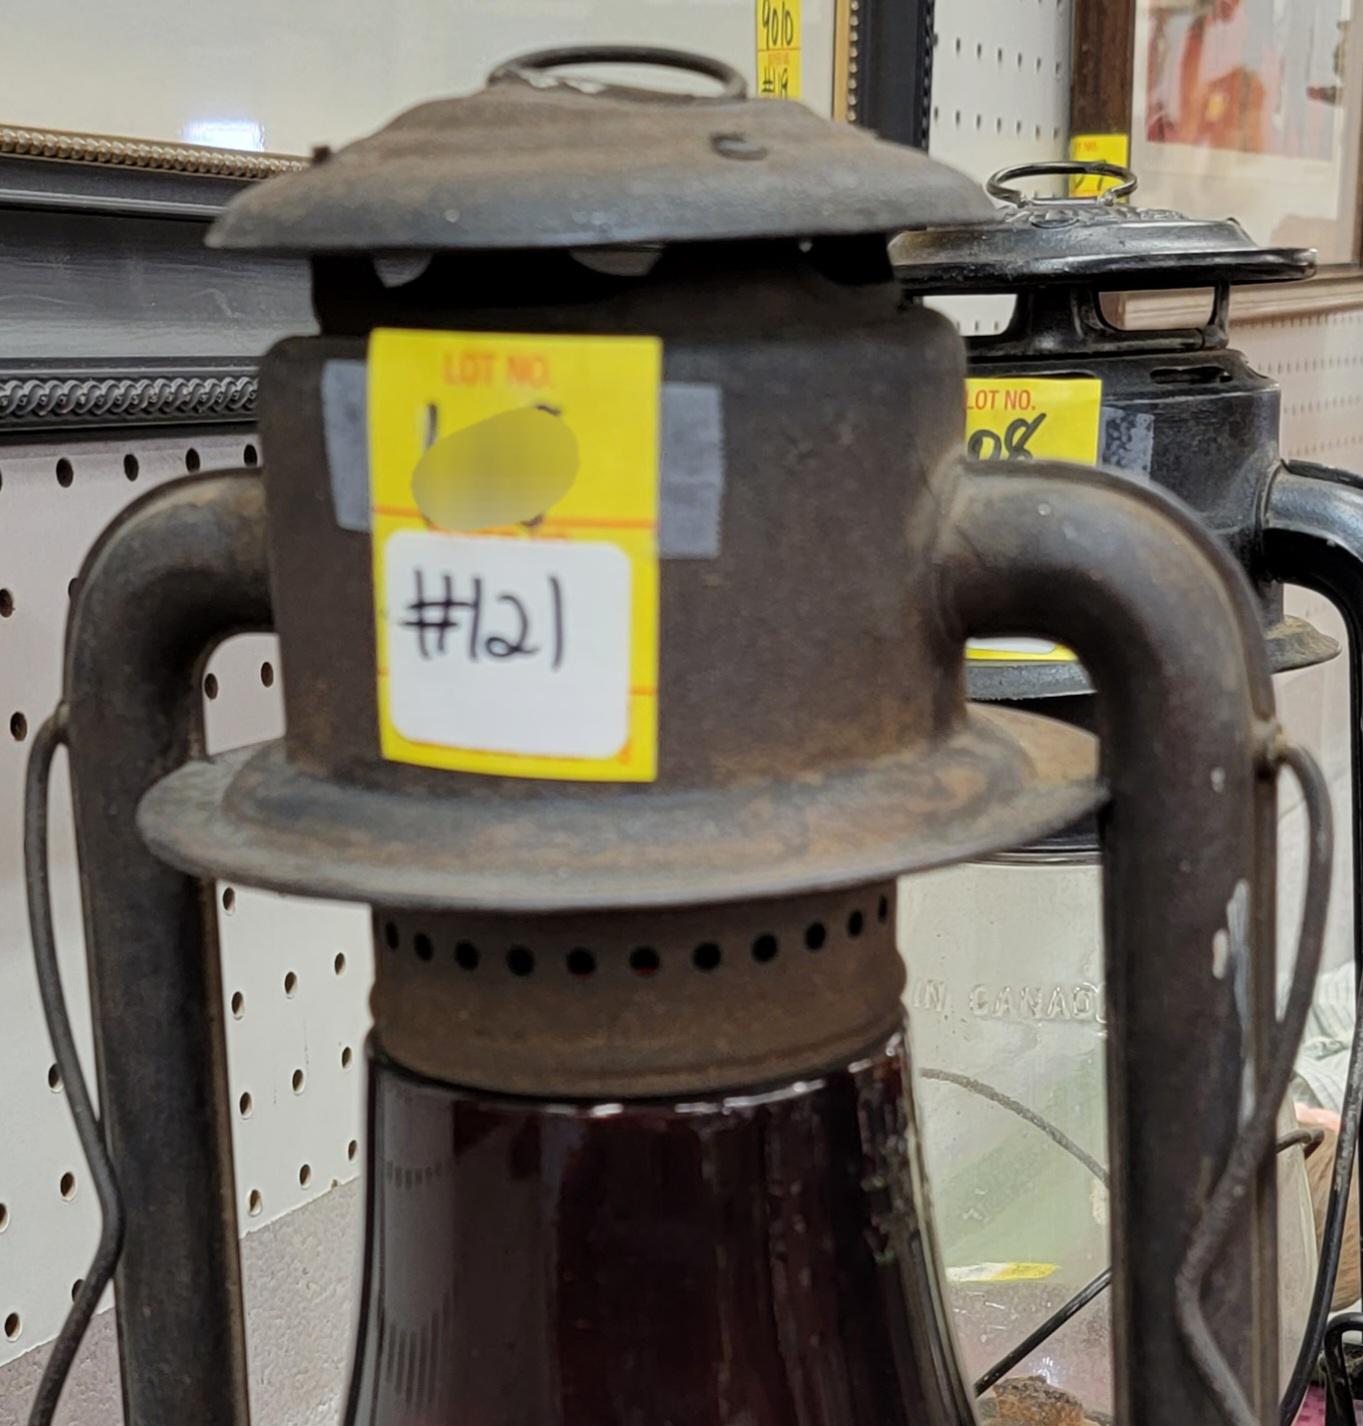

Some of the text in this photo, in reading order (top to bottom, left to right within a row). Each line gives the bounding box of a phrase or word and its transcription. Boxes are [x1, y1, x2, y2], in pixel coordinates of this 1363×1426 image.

[443, 352, 496, 387] LOT
[1004, 390, 1036, 411] NO.
[402, 568, 563, 672] #121
[912, 978, 1106, 1023] IN CANAD
